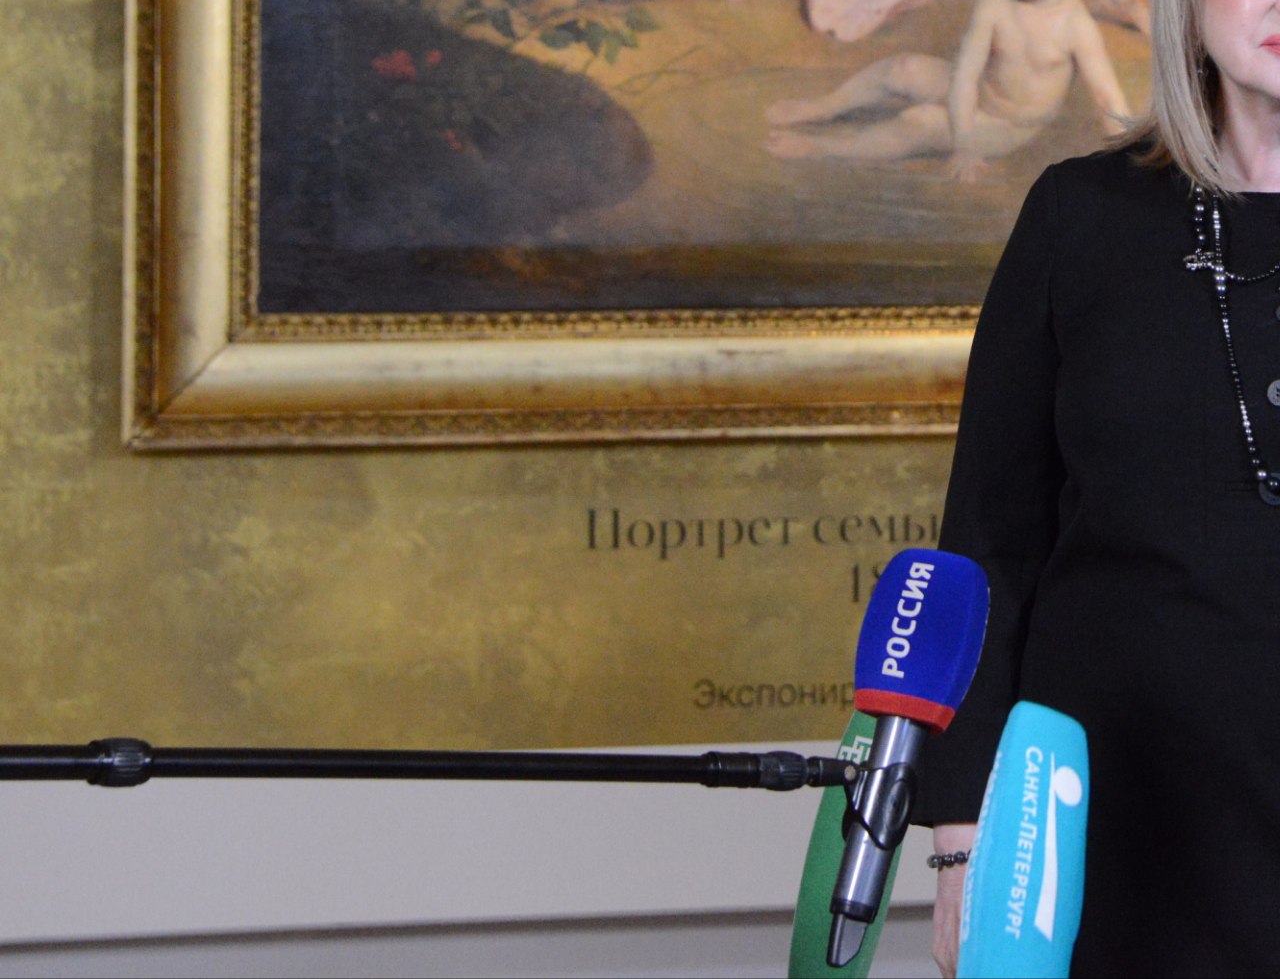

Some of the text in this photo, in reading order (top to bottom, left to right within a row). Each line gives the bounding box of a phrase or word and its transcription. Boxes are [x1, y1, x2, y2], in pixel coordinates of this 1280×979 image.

[587, 508, 799, 560] Портрет
[881, 561, 935, 679] РОССИЯ
[1005, 745, 1044, 940] САНКТ-ПЕТЕРБУРГ
